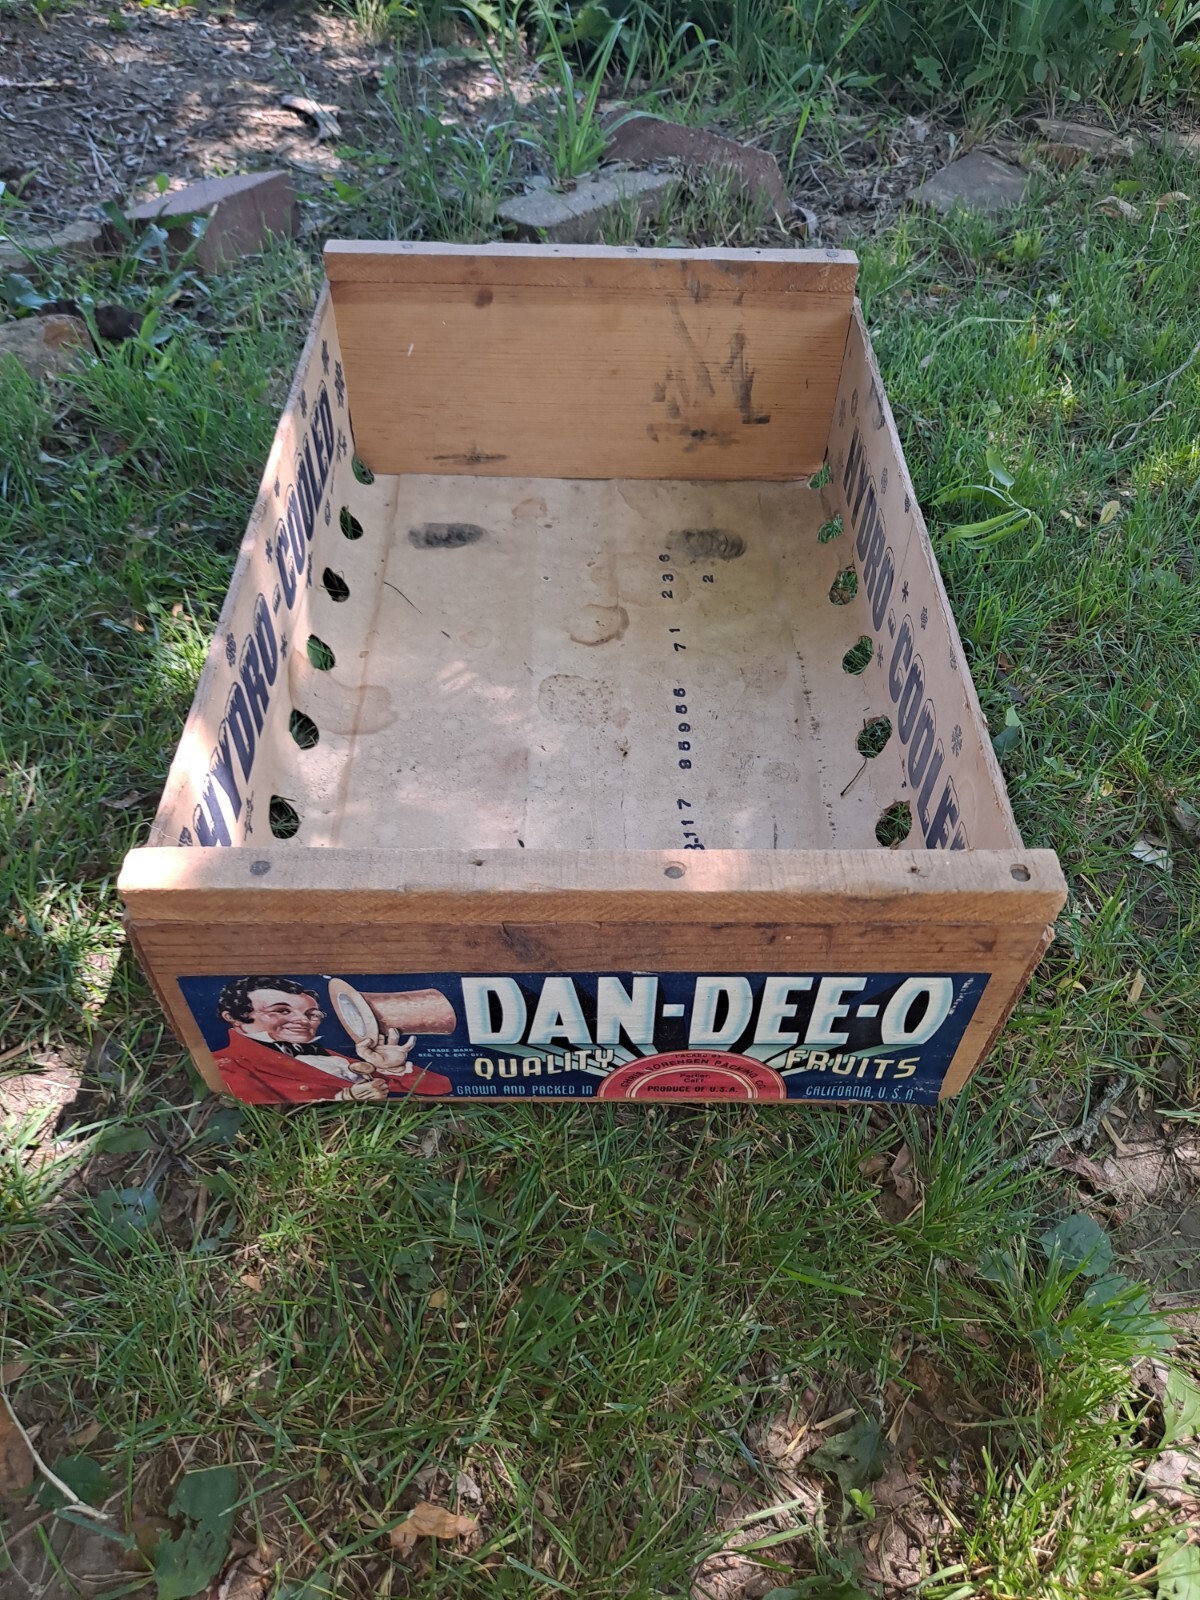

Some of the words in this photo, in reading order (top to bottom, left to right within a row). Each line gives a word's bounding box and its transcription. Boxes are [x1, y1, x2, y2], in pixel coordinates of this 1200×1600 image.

[843, 417, 971, 849] HYDRO-COOLE
[461, 976, 954, 1045] DAN-DEE-O
[475, 1049, 614, 1080] QUALITY
[621, 1071, 644, 1088] CHRIS
[645, 1059, 709, 1072] SORENSEN
[714, 1060, 758, 1079] PACKING
[785, 1050, 921, 1080] FRUITS
[457, 1084, 497, 1095] GROWN
[503, 1084, 526, 1095] AND
[532, 1084, 576, 1095] PACKED
[582, 1084, 593, 1095] IN
[647, 1085, 690, 1093] PRODUCE
[805, 1085, 874, 1099] CALIFORNIA,
